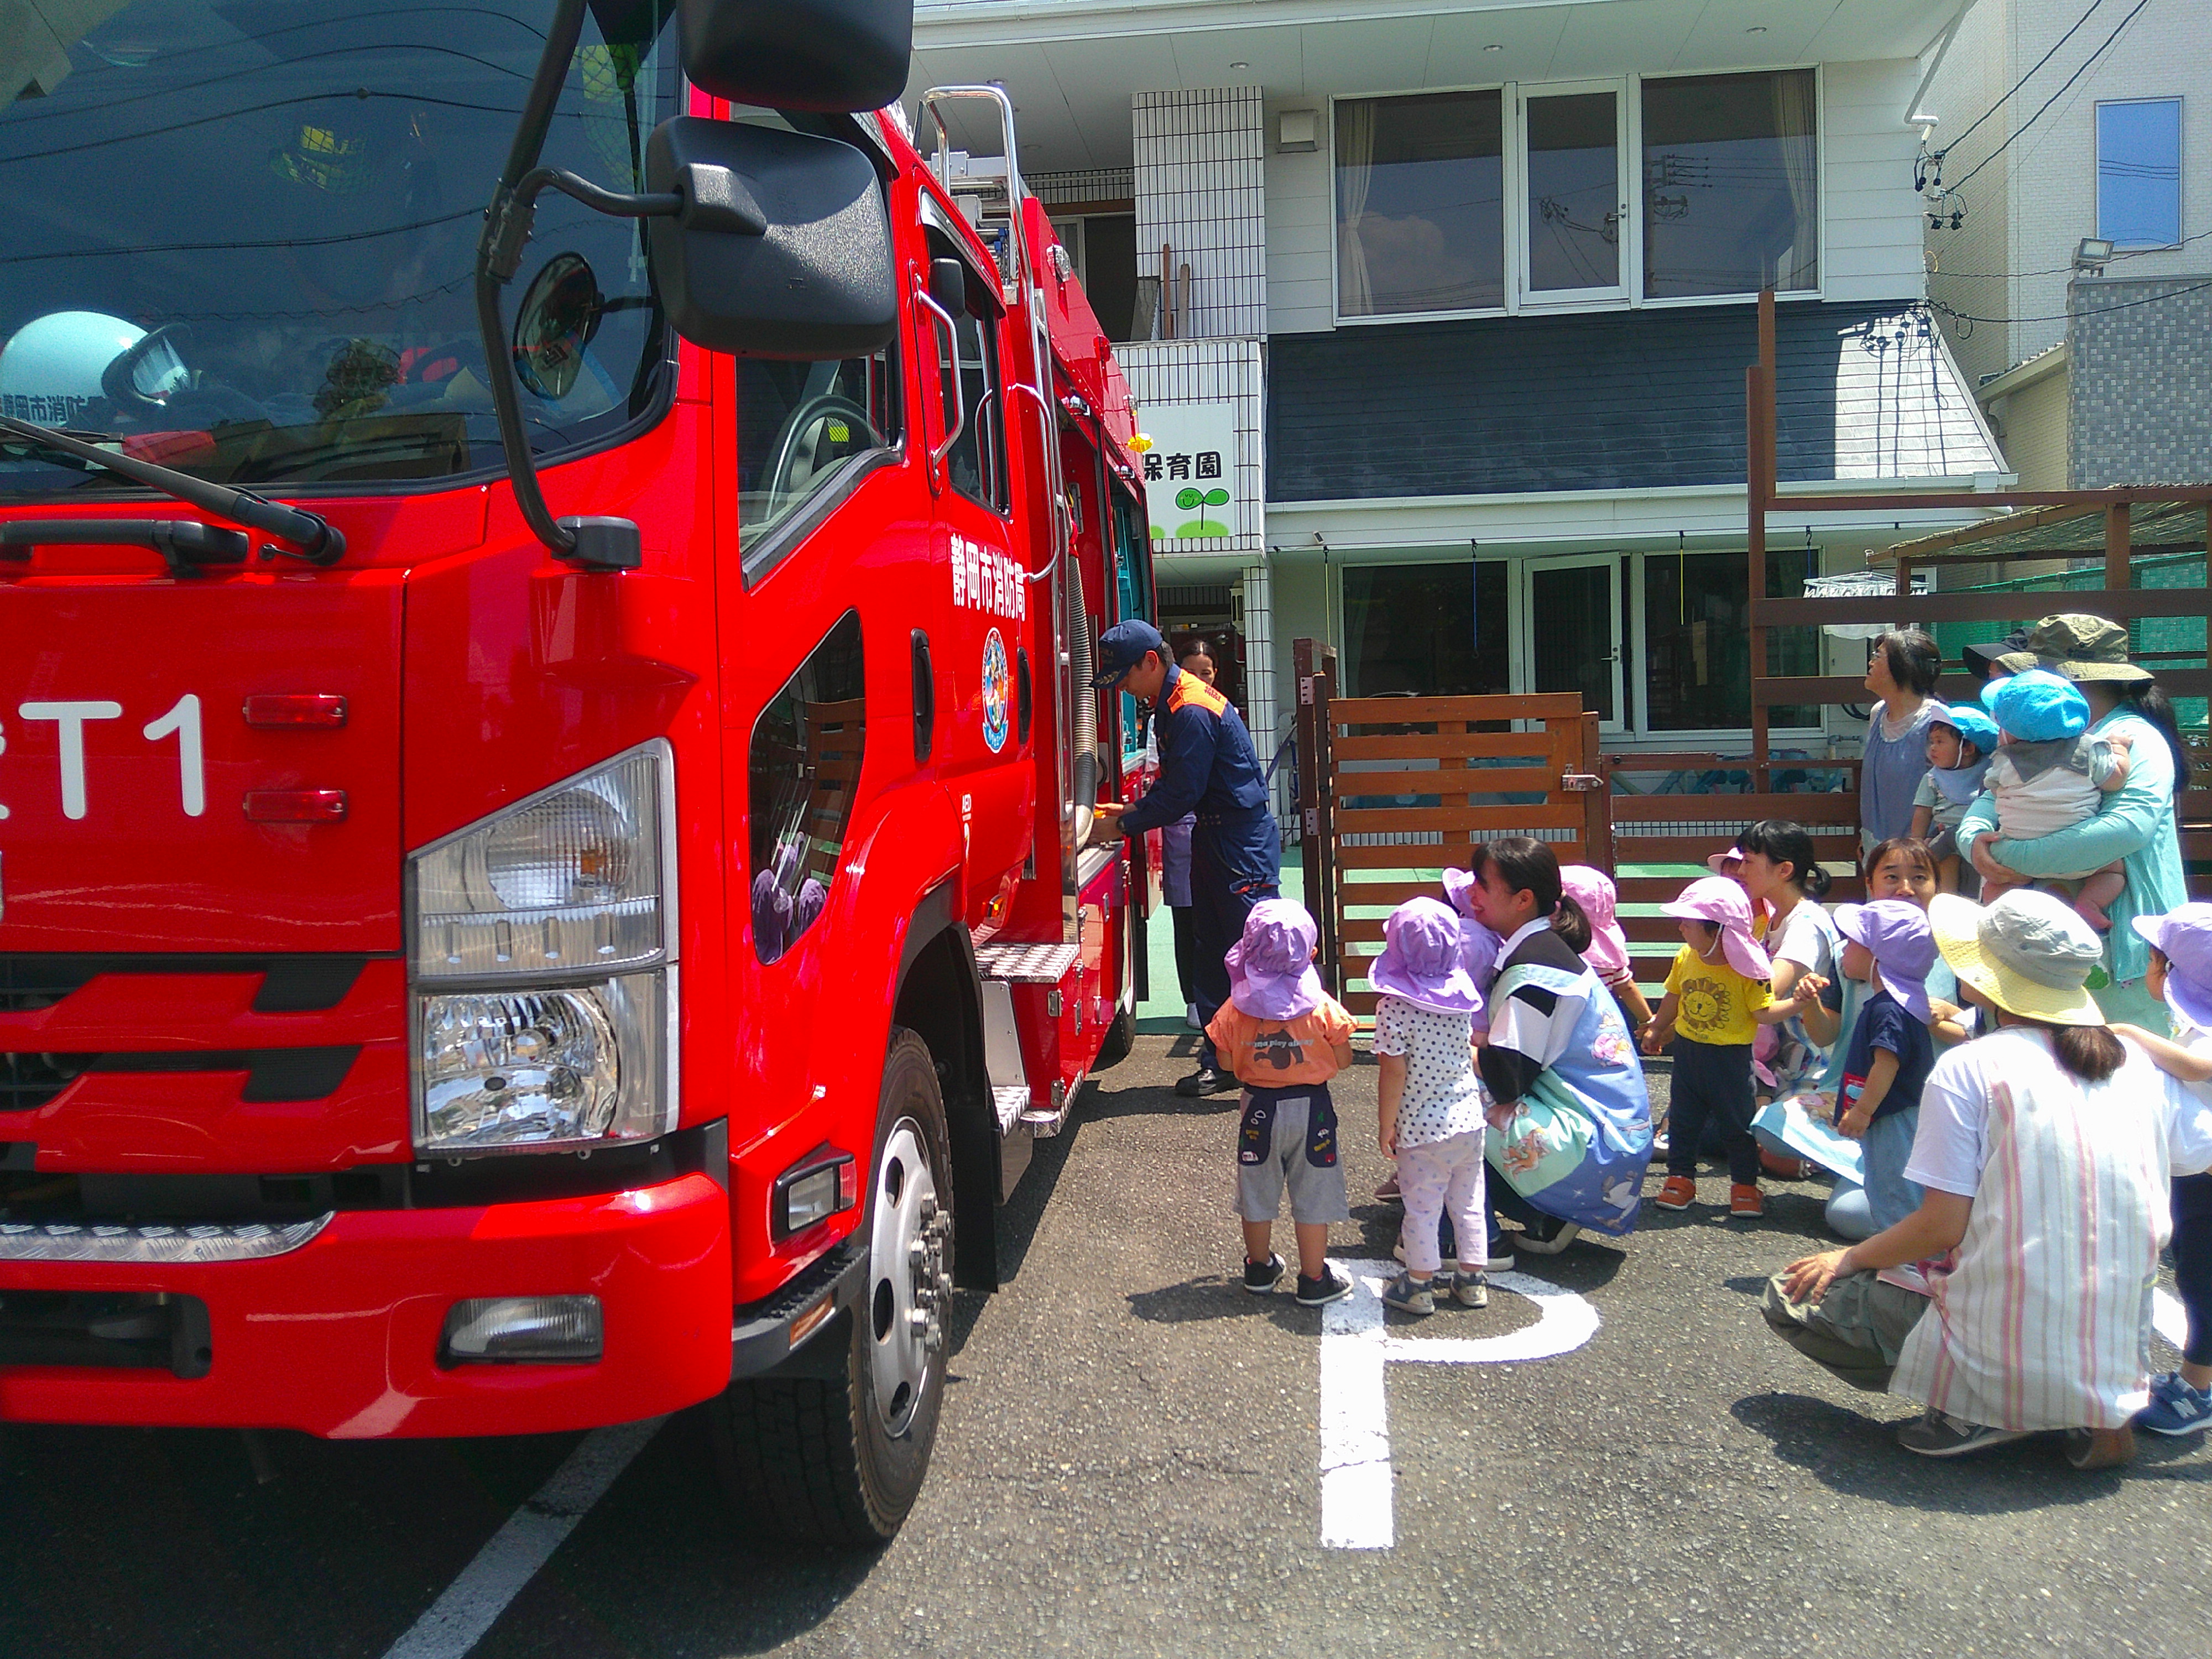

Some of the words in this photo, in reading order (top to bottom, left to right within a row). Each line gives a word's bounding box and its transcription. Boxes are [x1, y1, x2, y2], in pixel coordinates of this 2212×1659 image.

[3, 393, 103, 422] 静岡市消防
[1142, 451, 1222, 481] 保育園
[951, 533, 1025, 622] 静岡市消防局
[0, 693, 204, 820] T1
[962, 794, 972, 813] AED
[1269, 1040, 1287, 1048] play
